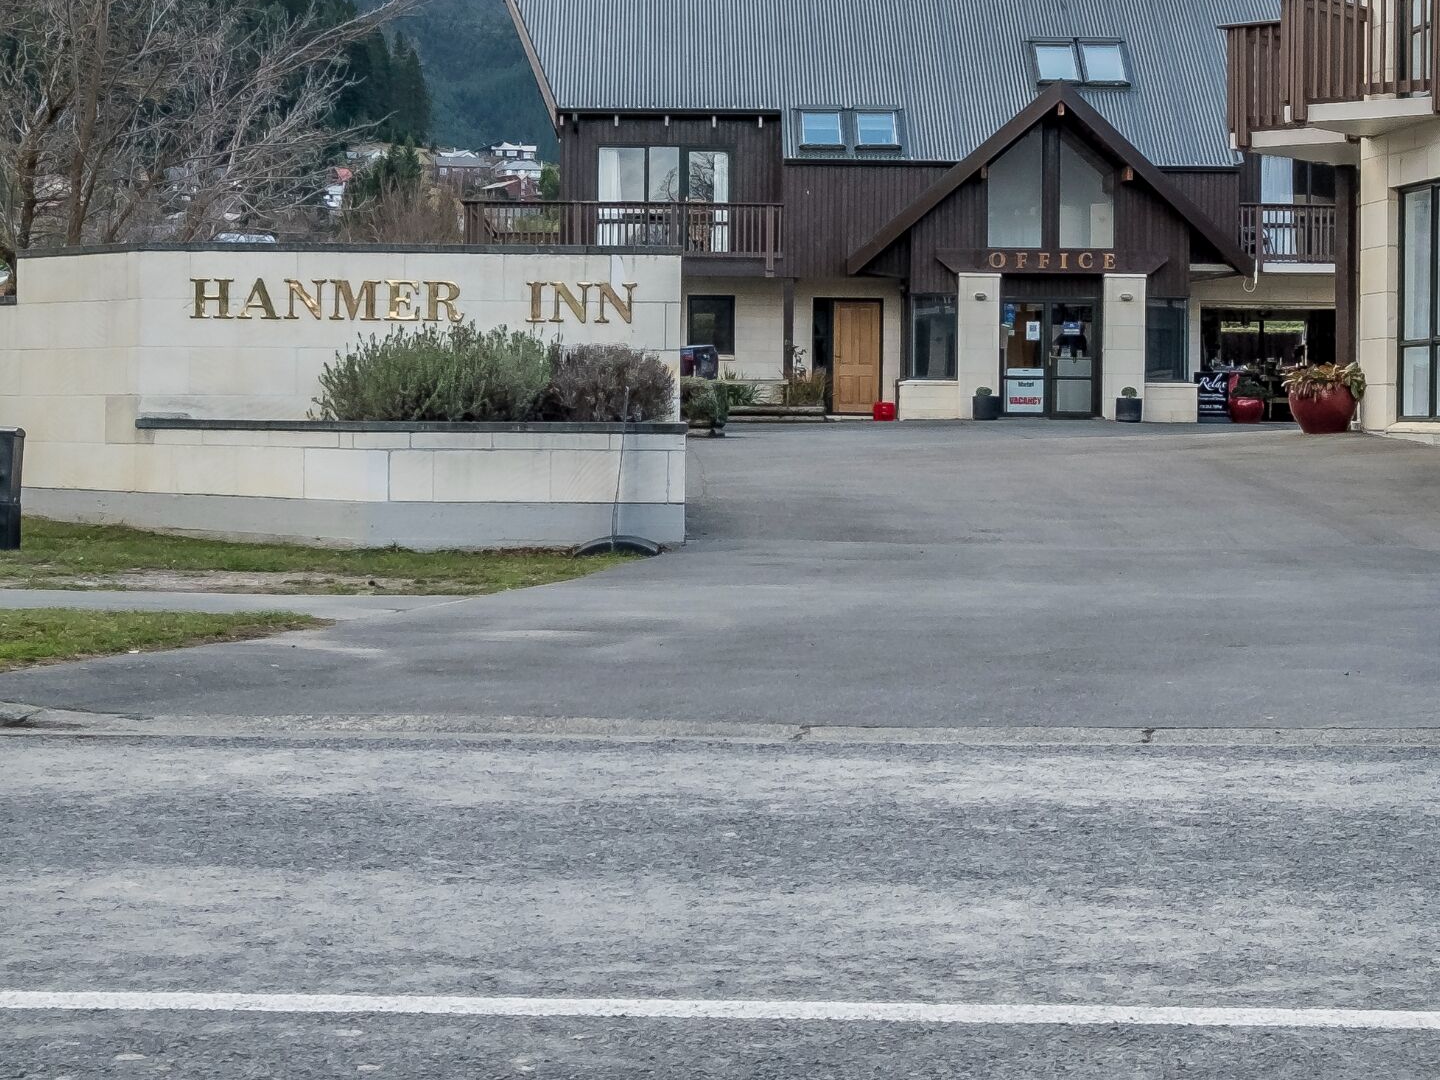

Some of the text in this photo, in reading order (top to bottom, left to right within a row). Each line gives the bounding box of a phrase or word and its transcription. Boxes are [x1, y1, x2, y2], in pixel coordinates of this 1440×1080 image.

[988, 252, 1116, 269] OFFICE
[189, 277, 638, 324] HANMER INN
[1198, 373, 1227, 393] Relax
[1009, 396, 1042, 405] VACANCY
